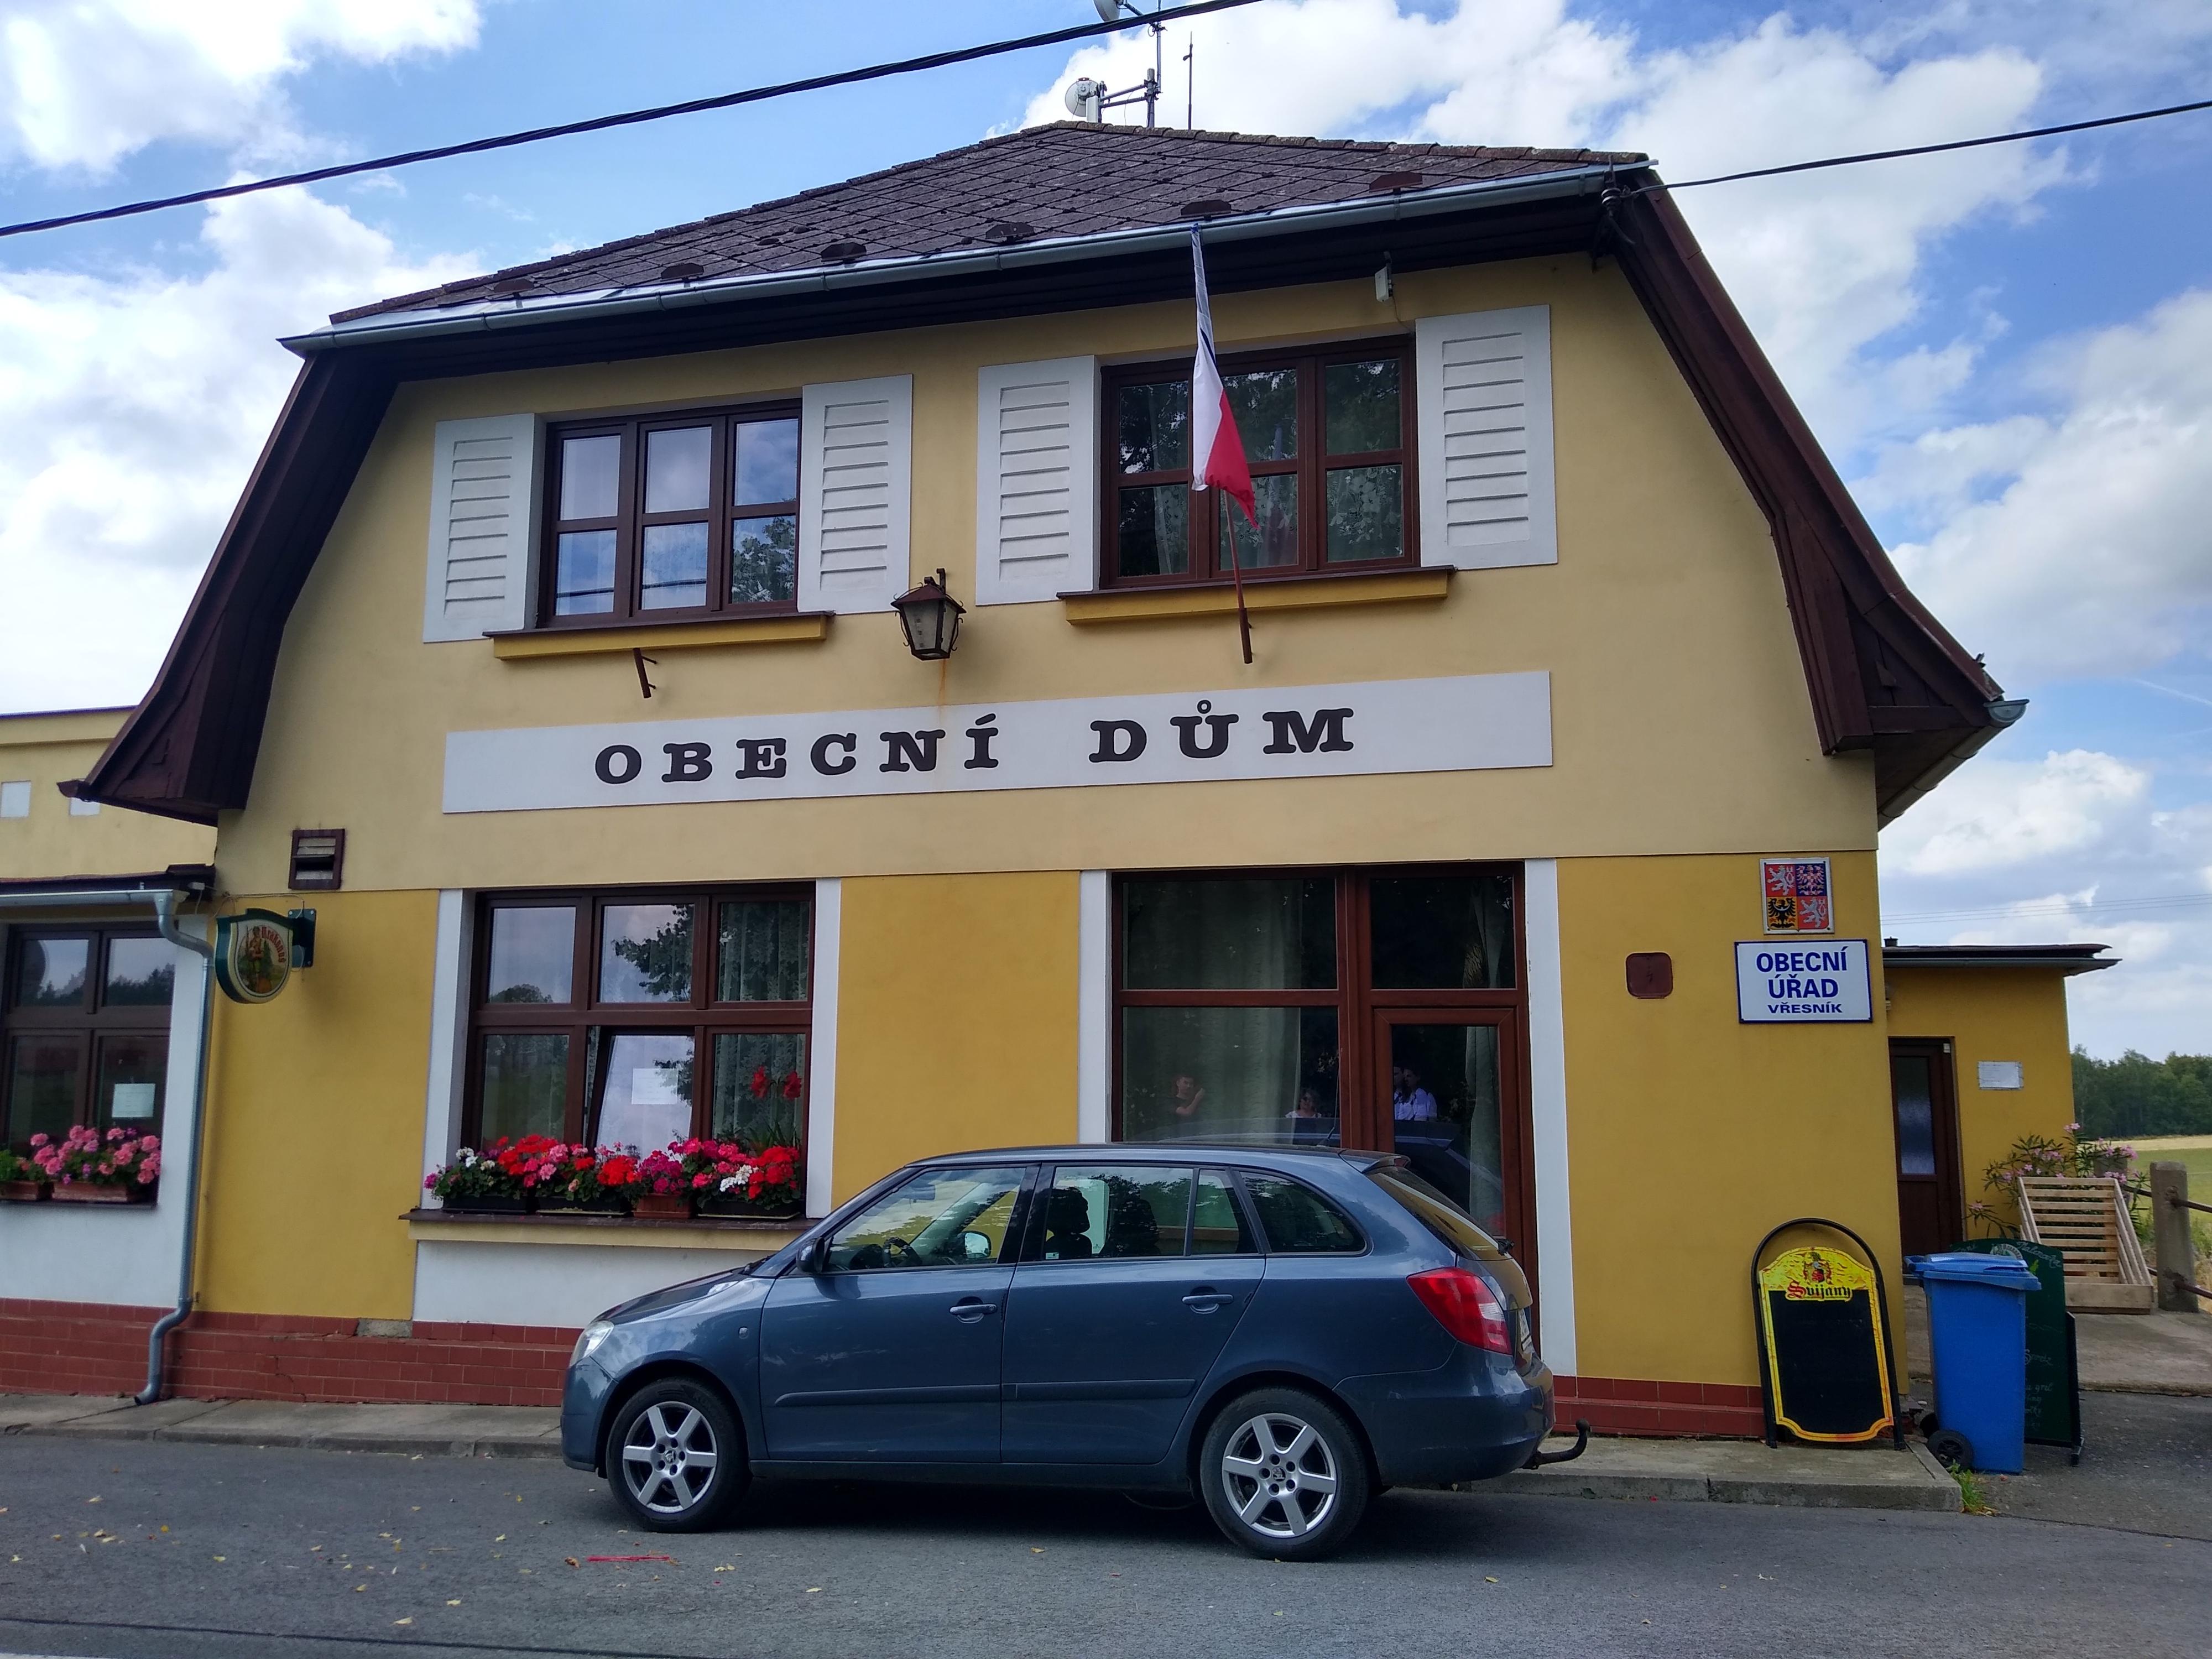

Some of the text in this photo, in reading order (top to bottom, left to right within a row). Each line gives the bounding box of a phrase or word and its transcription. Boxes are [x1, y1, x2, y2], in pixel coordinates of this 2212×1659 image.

[594, 700, 1354, 785] OBECNÍ DŮM
[1756, 946, 1849, 973] OBECNÍ
[1768, 973, 1839, 999] ÚŘAD
[1767, 1001, 1843, 1014] VŘESNÍK
[1786, 1279, 1851, 1300] Svijany
